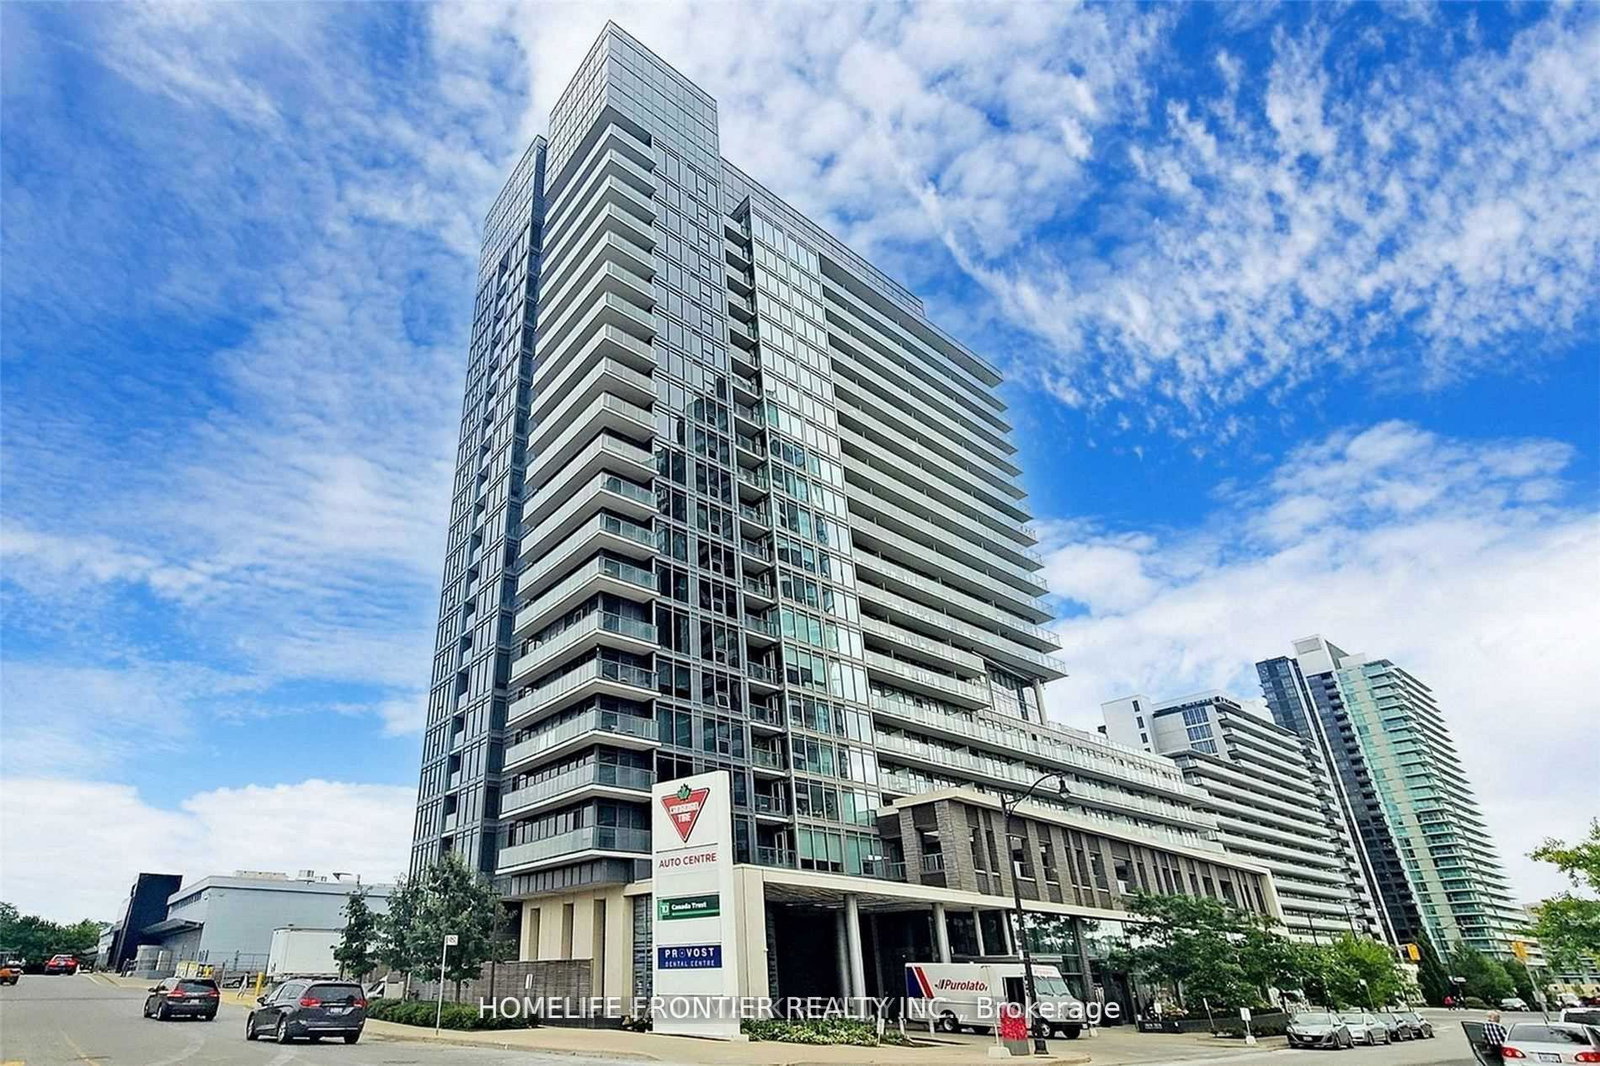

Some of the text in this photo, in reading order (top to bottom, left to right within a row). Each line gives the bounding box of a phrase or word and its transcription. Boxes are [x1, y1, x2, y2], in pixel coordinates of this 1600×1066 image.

[659, 852, 717, 868] AUTO CENTRE
[660, 904, 669, 913] TD
[665, 948, 715, 958] PROVOST
